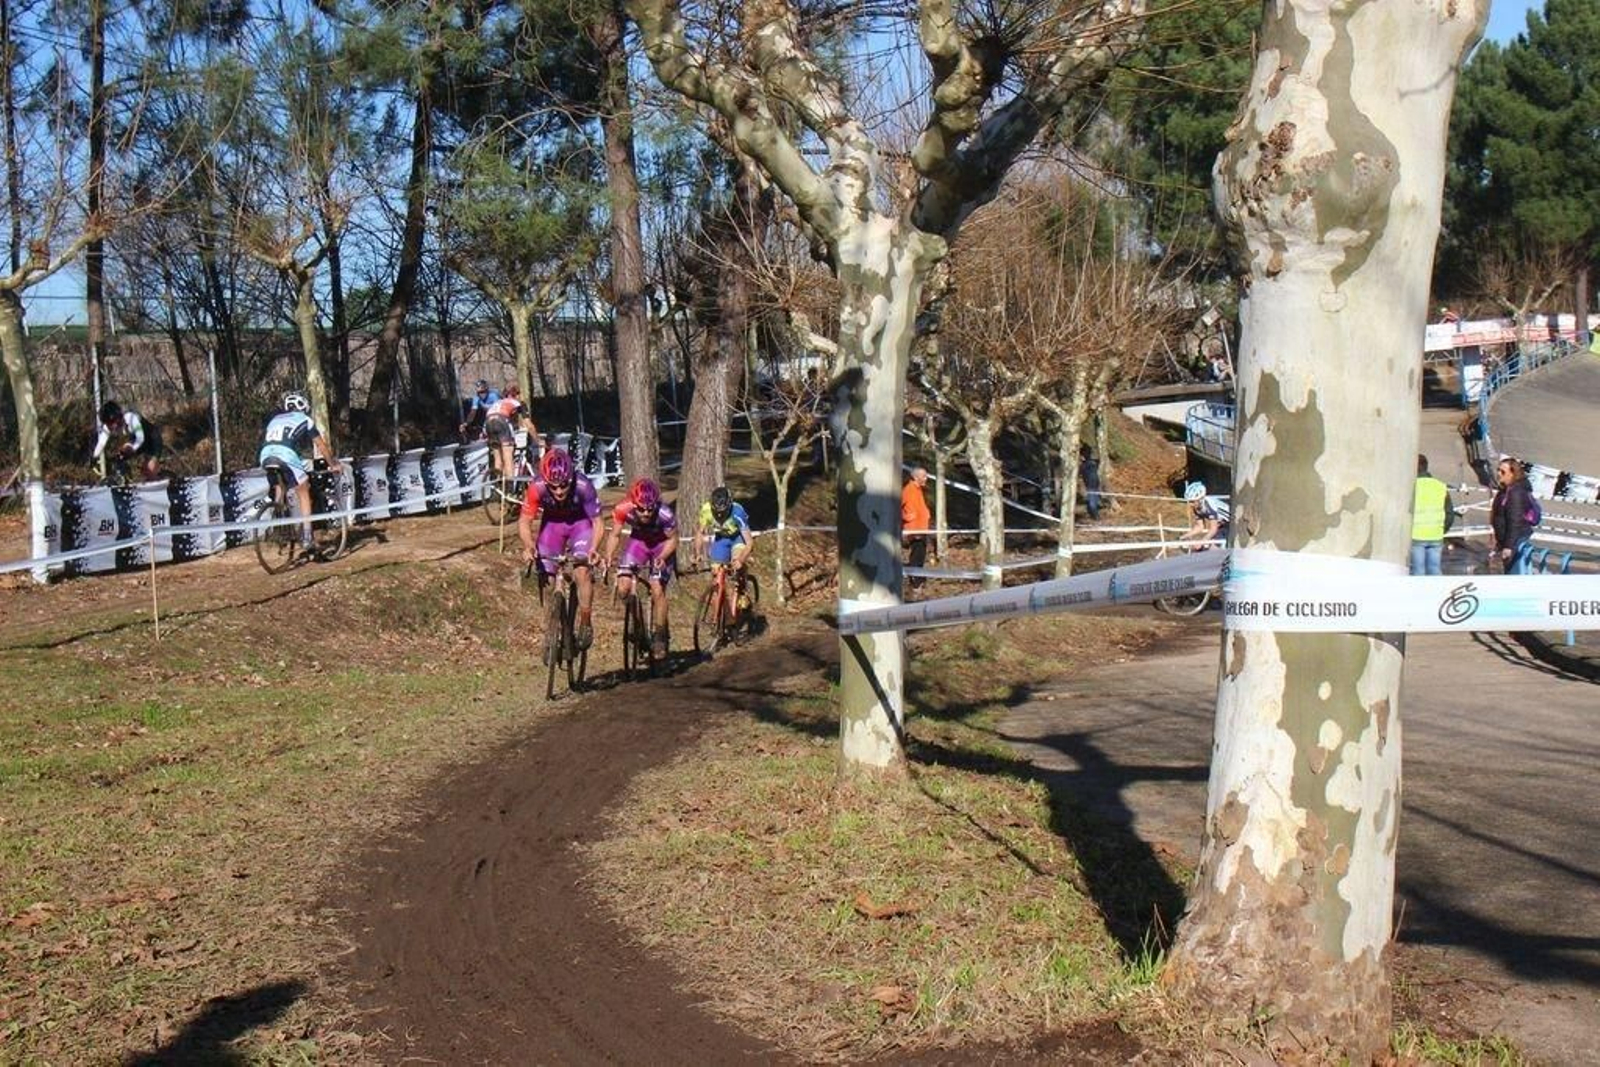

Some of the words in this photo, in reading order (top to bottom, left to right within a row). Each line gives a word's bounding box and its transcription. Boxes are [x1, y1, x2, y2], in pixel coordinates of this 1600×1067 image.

[99, 519, 115, 532] BH
[150, 513, 165, 526] BH
[44, 524, 57, 538] BH
[1263, 602, 1281, 616] DE
[1286, 601, 1358, 617] CICLISMO
[1549, 600, 1600, 616] FEDER
